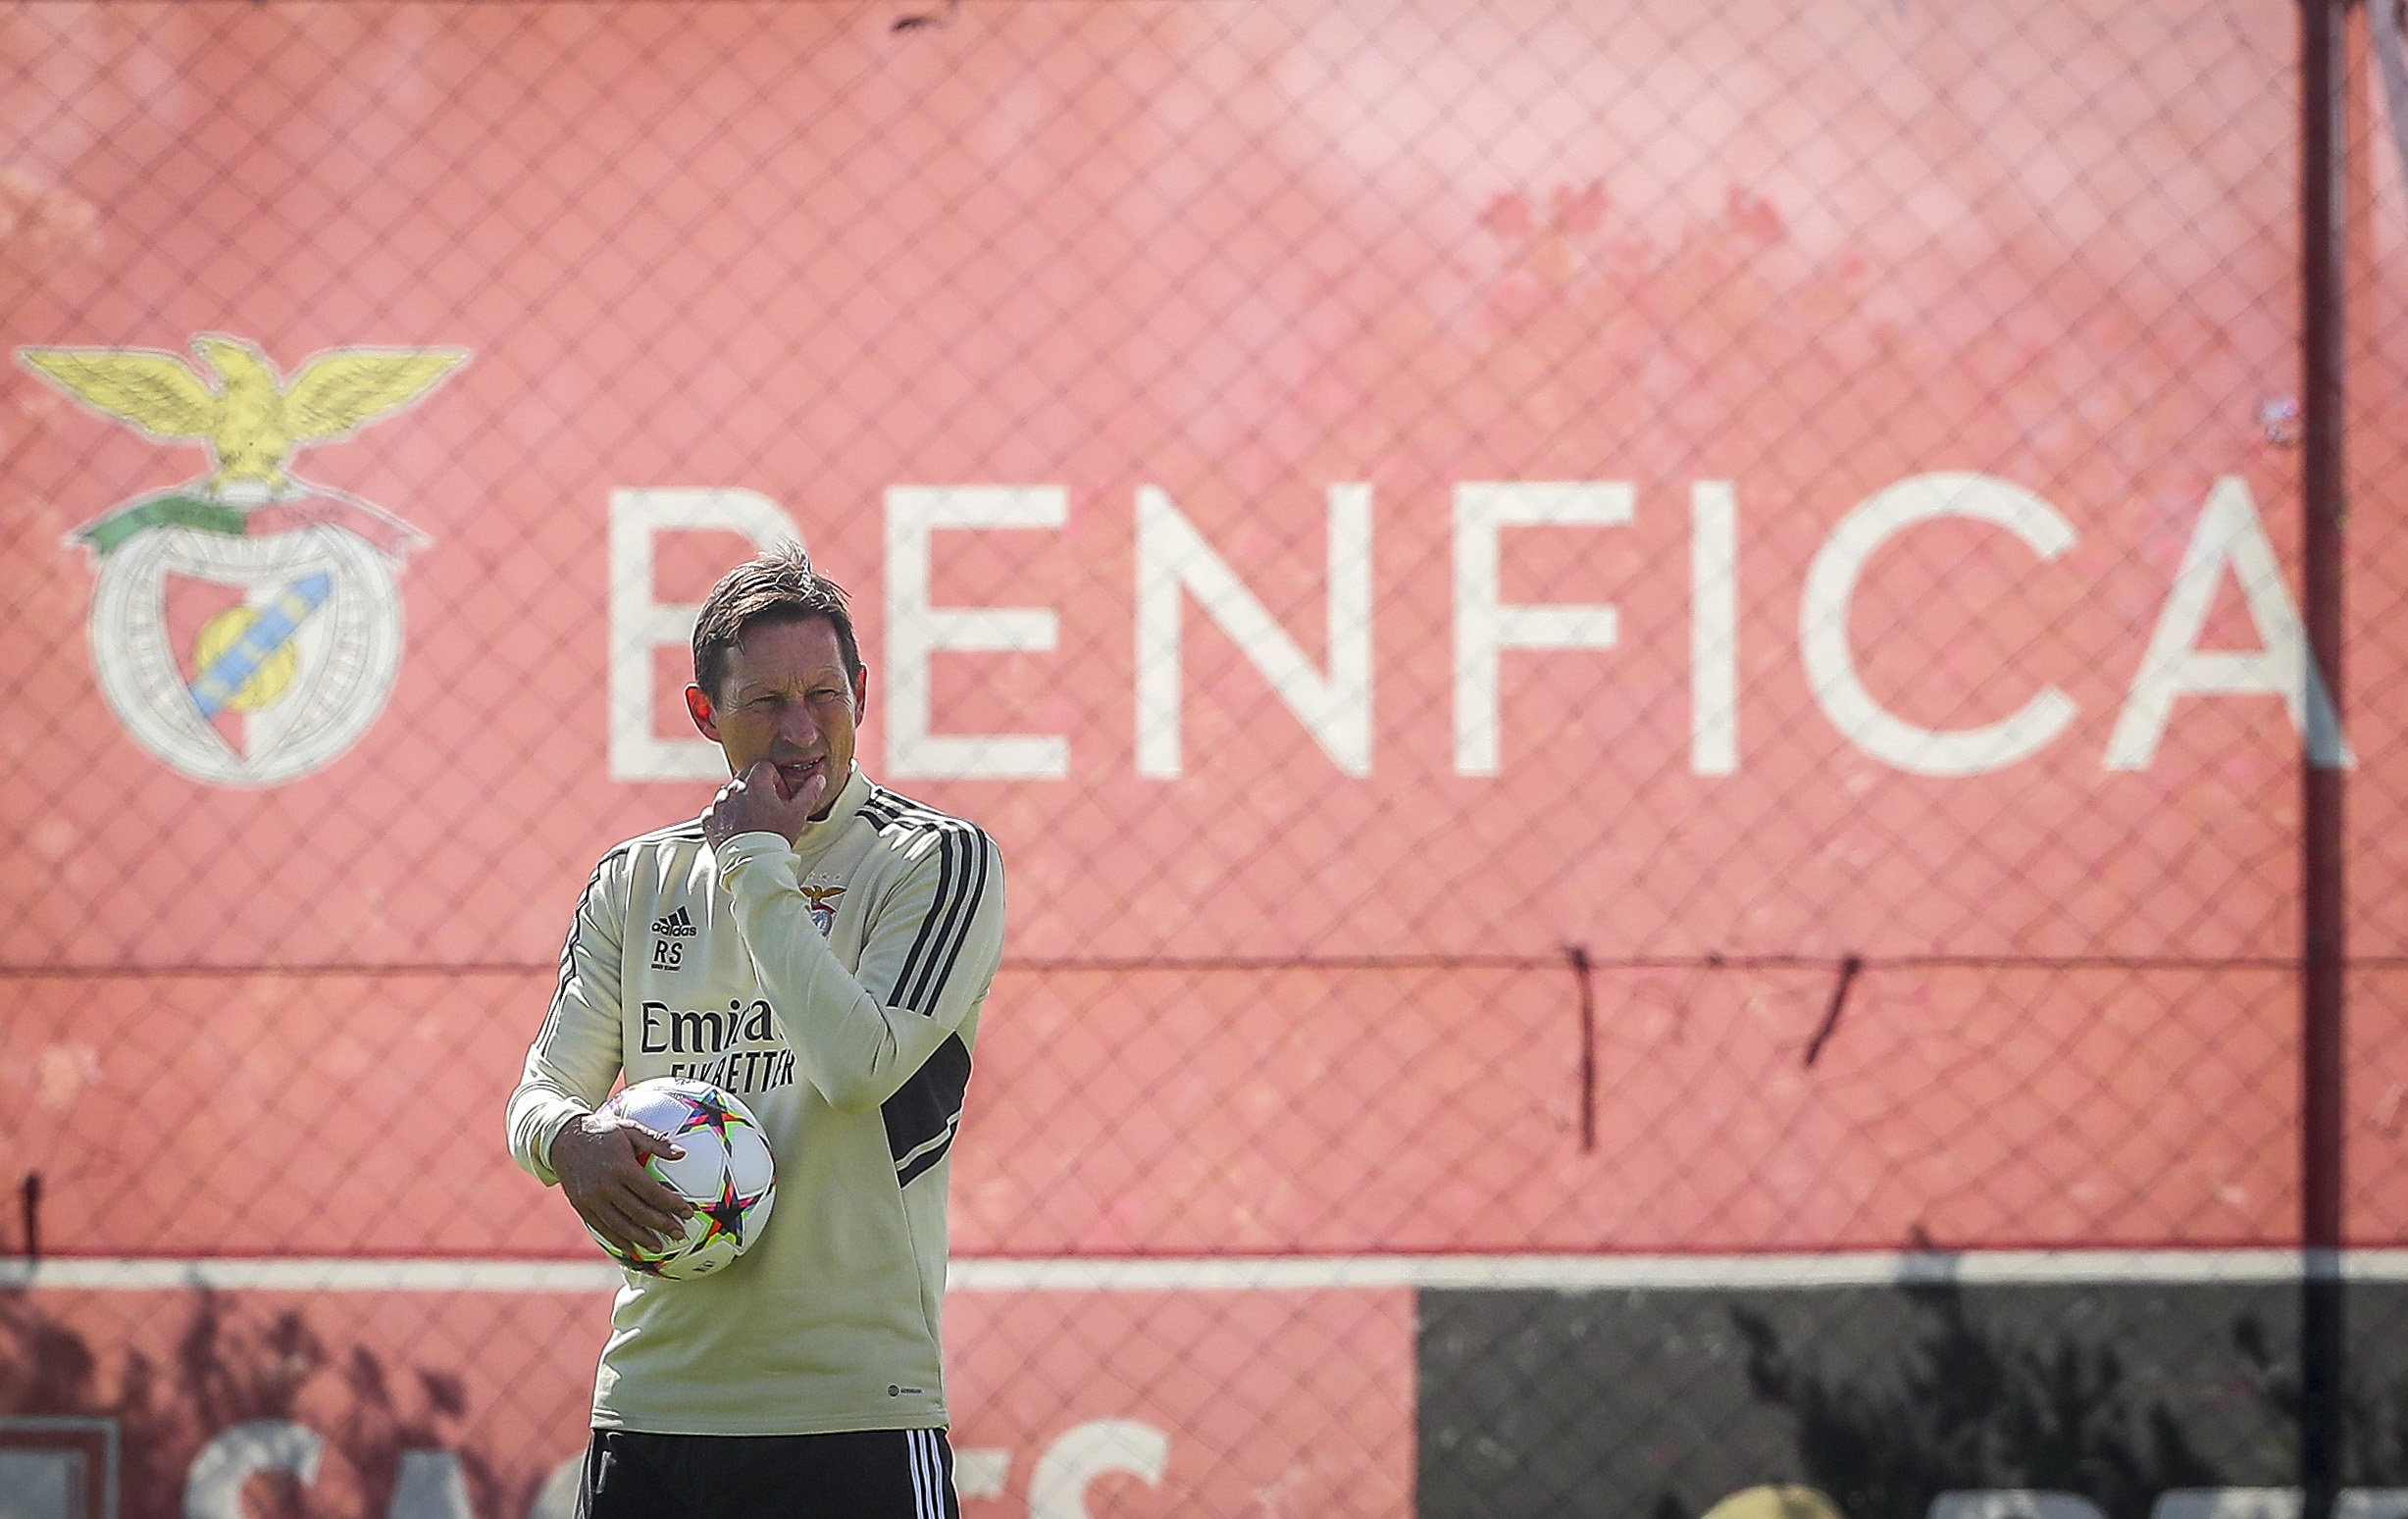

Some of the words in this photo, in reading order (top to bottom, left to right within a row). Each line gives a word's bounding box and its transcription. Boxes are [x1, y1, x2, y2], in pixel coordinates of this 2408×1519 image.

[607, 469, 2356, 783] BENFICA
[651, 922, 697, 937] adidas
[653, 938, 683, 964] RS
[640, 999, 785, 1054] Emia
